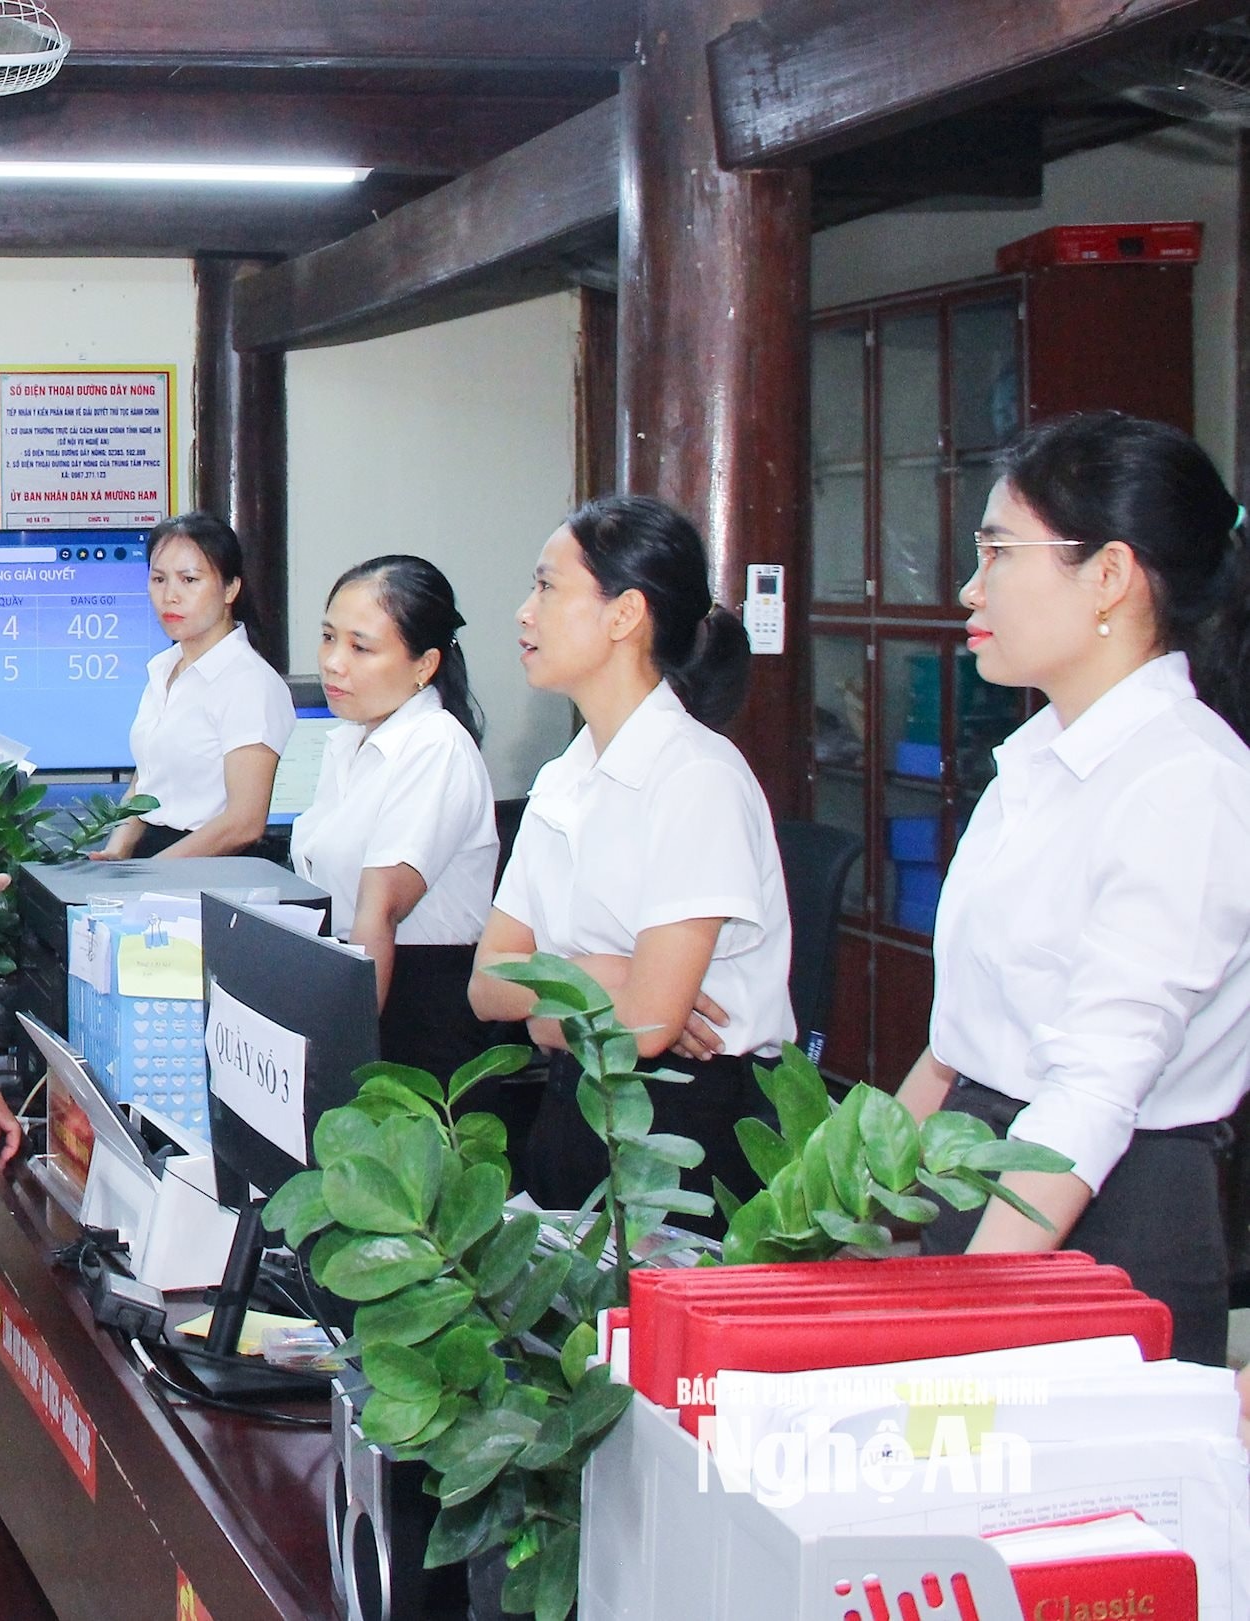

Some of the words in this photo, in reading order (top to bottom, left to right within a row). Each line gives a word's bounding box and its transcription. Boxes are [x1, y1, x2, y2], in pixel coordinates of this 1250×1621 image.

[9, 382, 22, 396] SỐ
[24, 384, 46, 398] ĐIỆN
[48, 385, 74, 398] THOẠI
[77, 384, 108, 396] ĐƯỜNG
[110, 384, 128, 395] DÂY
[130, 384, 156, 396] NÓNG
[10, 489, 21, 501] ỦY
[24, 491, 41, 501] BAN
[44, 490, 68, 501] NHÂN
[70, 490, 88, 501] DÂN
[91, 489, 102, 501] XÃ
[104, 490, 135, 500] MƯỜNG
[138, 491, 157, 500] HAM
[14, 567, 37, 582] GIẢI
[39, 566, 76, 582] QUYẾT
[70, 597, 98, 606] ĐANG
[100, 596, 116, 607] GỌI
[2, 615, 19, 640] 4
[67, 613, 119, 640] 402
[3, 655, 19, 681] 5
[68, 654, 119, 680] 502
[215, 1021, 254, 1078] QUẦY
[257, 1049, 277, 1094] SỐ
[281, 1069, 289, 1103] 3
[1035, 1589, 1155, 1621] Classic
